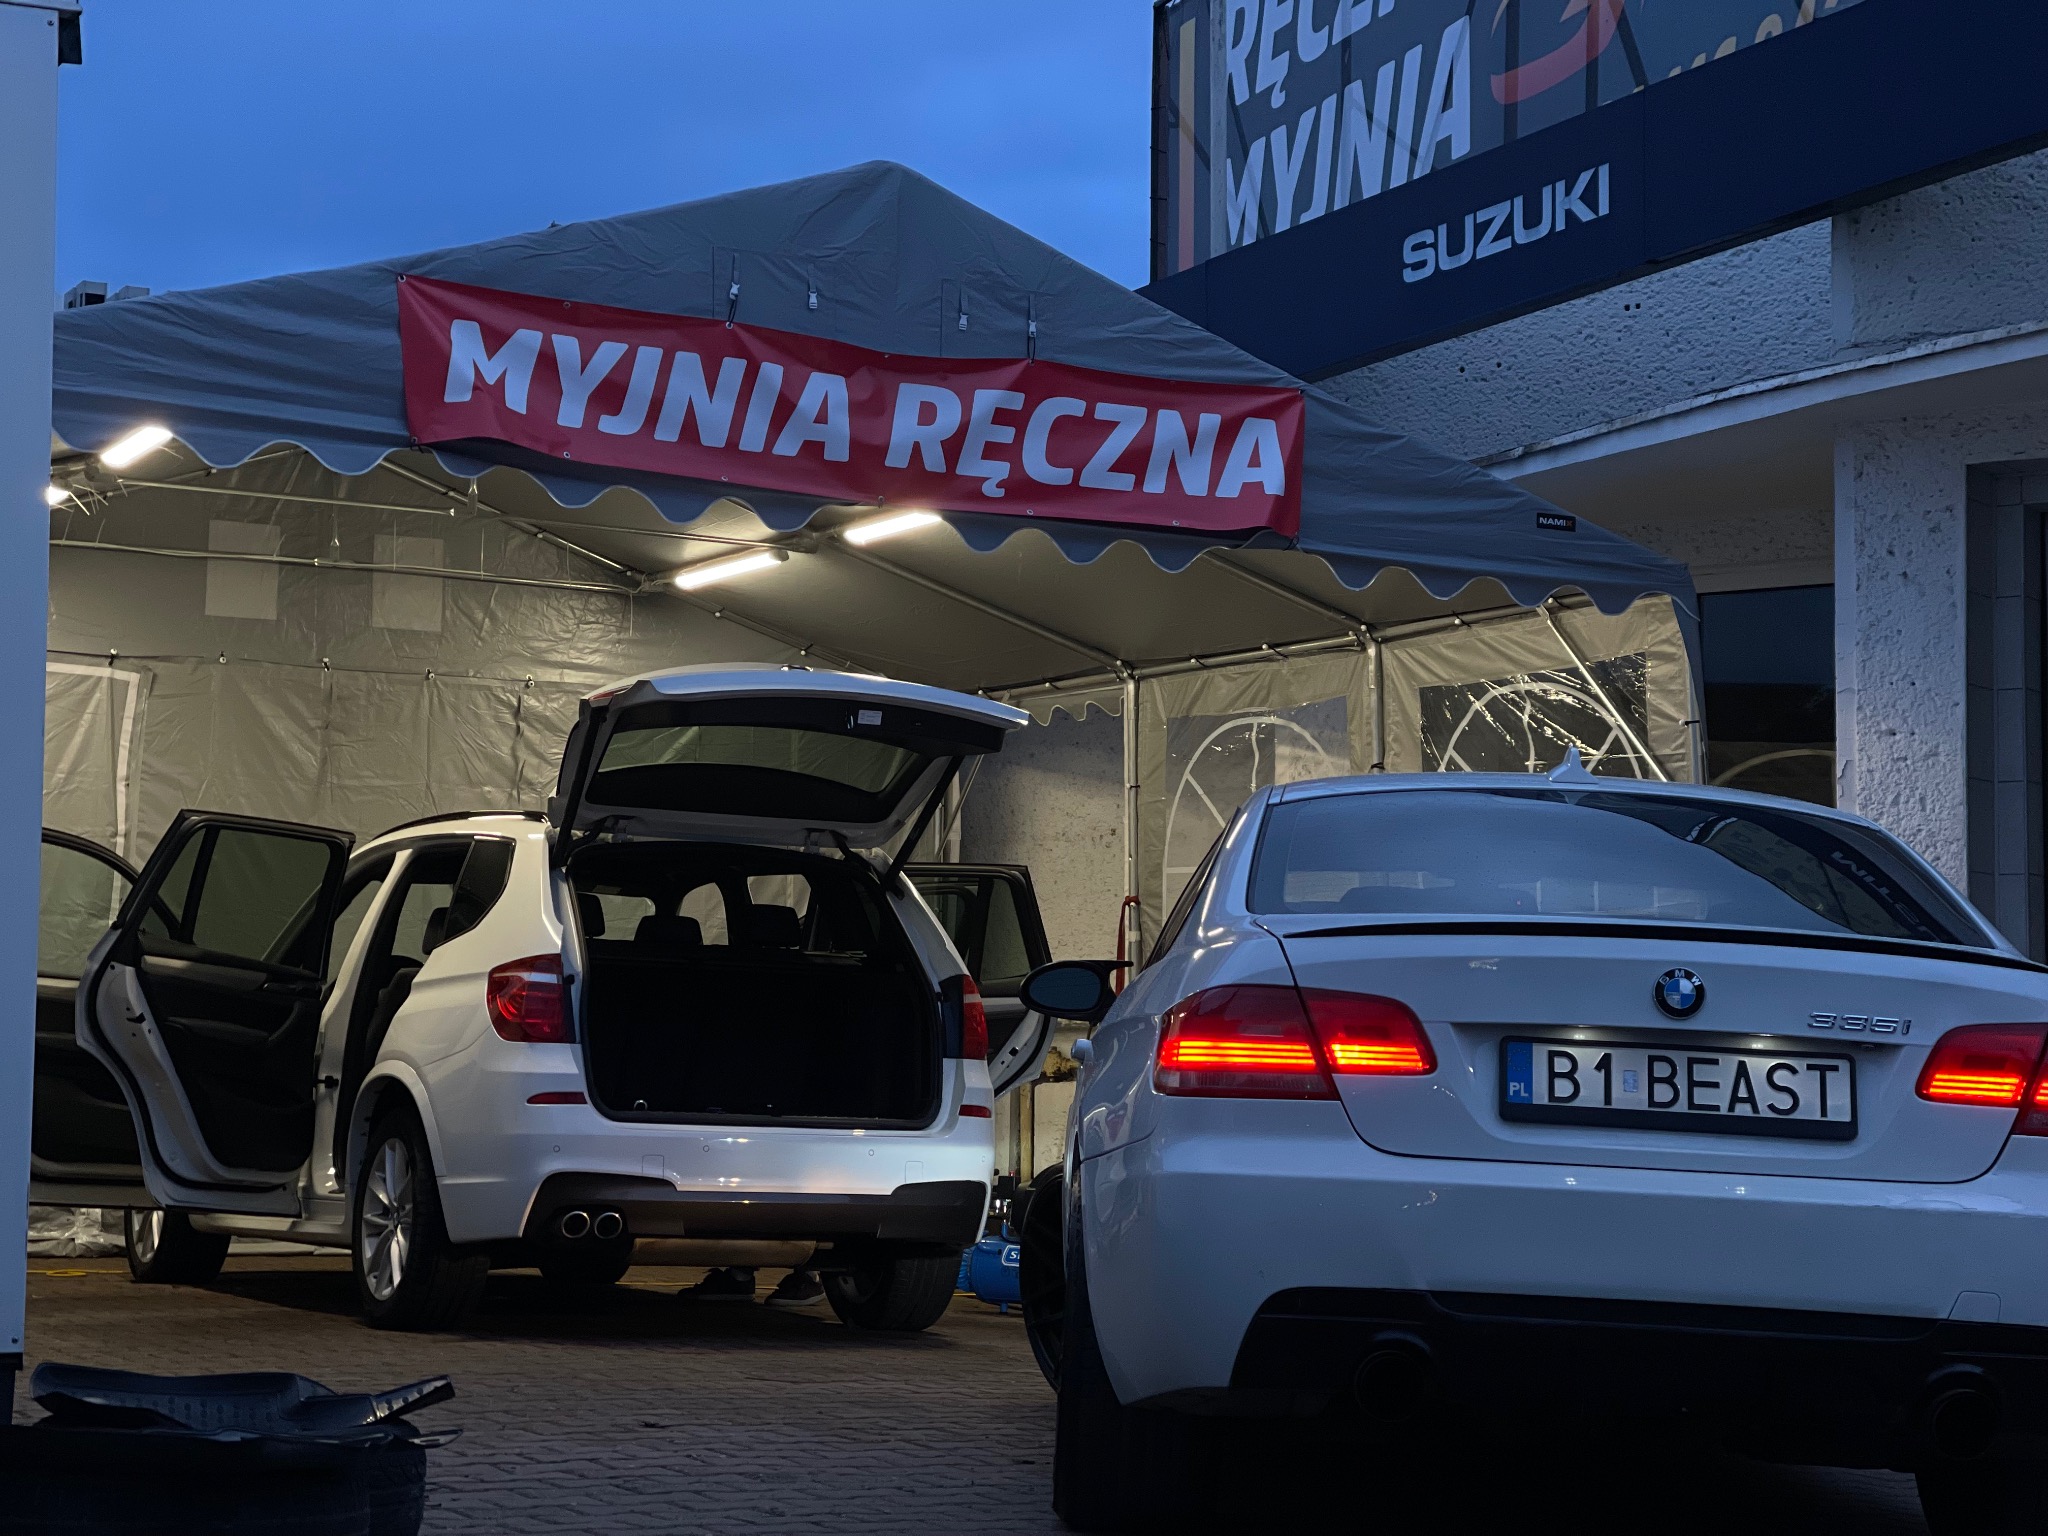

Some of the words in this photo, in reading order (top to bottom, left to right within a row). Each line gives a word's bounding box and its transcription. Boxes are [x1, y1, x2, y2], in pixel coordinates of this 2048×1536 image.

[1227, 15, 1470, 246] MYJNIA
[1402, 163, 1610, 284] SUZUKI
[443, 319, 850, 463] MYJNIA
[884, 382, 1286, 498] RĘCZNA
[1659, 969, 1702, 986] BMW
[1807, 1011, 1912, 1036] 335i
[1509, 1082, 1529, 1097] PL
[1548, 1049, 1613, 1107] B1
[1647, 1054, 1840, 1119] BEAST
